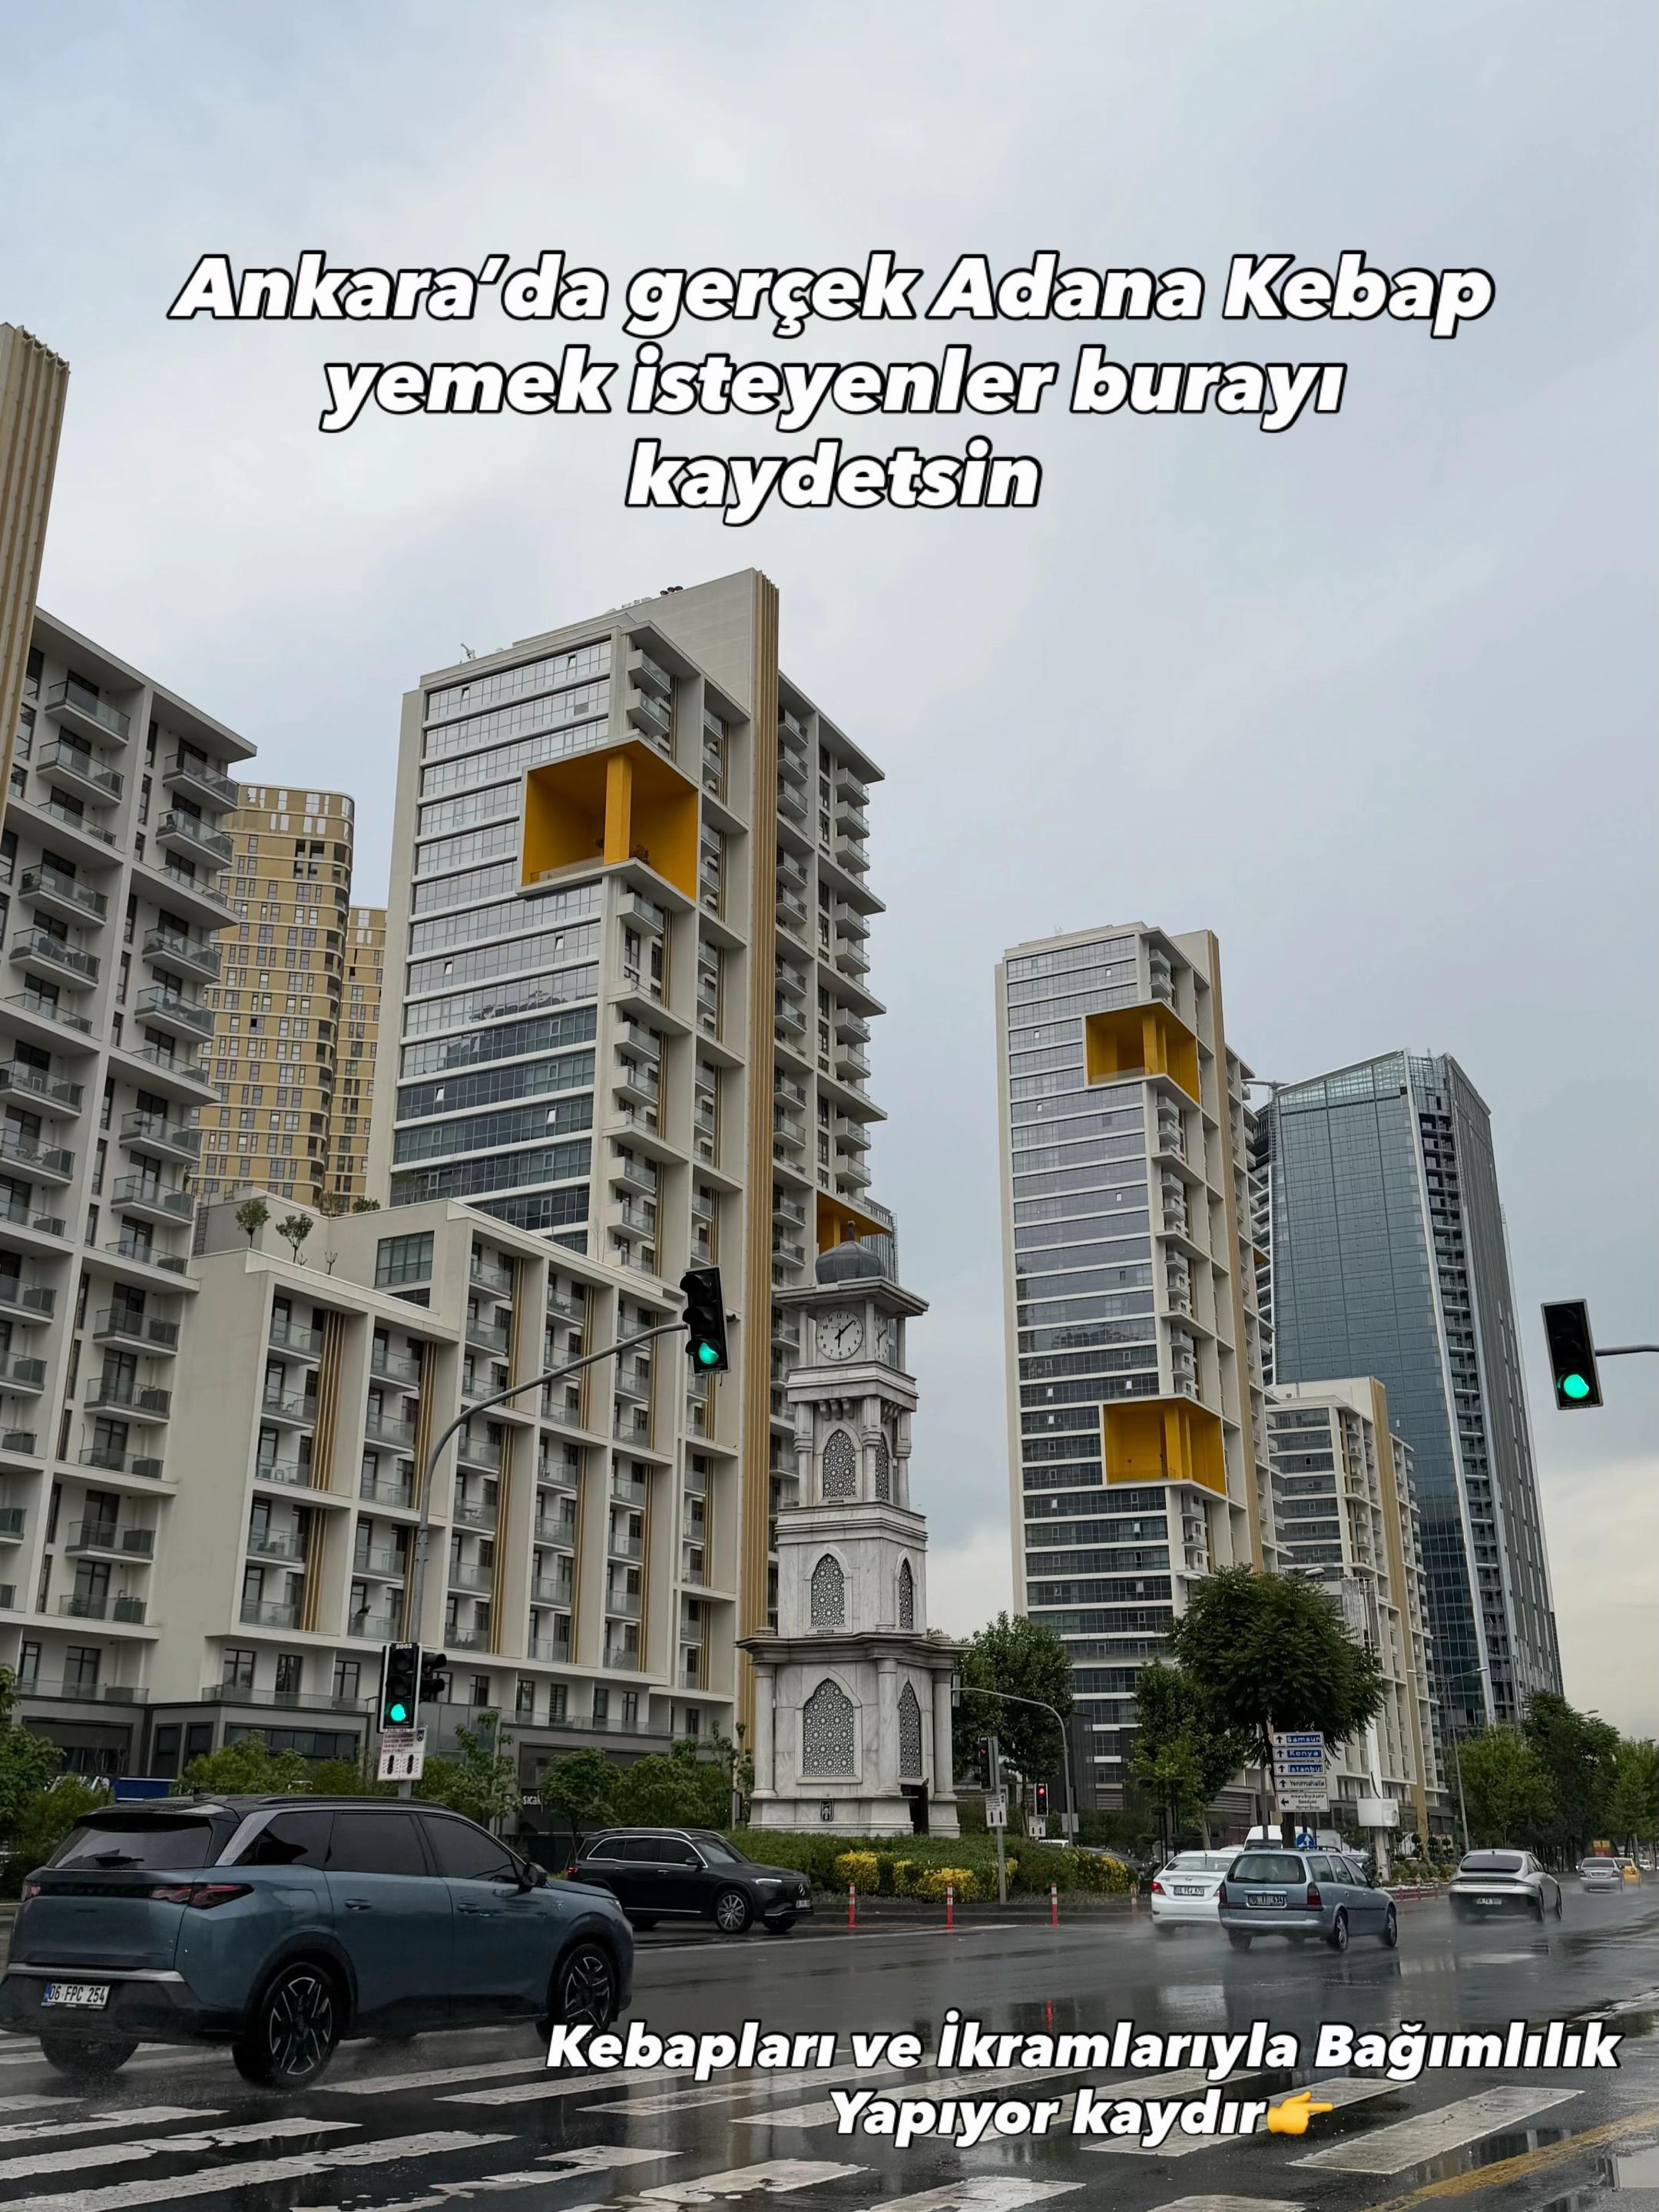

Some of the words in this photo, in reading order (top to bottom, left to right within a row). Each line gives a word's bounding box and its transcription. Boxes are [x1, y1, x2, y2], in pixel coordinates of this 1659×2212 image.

[48, 1985, 61, 2000] 06
[65, 1985, 84, 2002] FPC
[86, 1987, 105, 2003] 254
